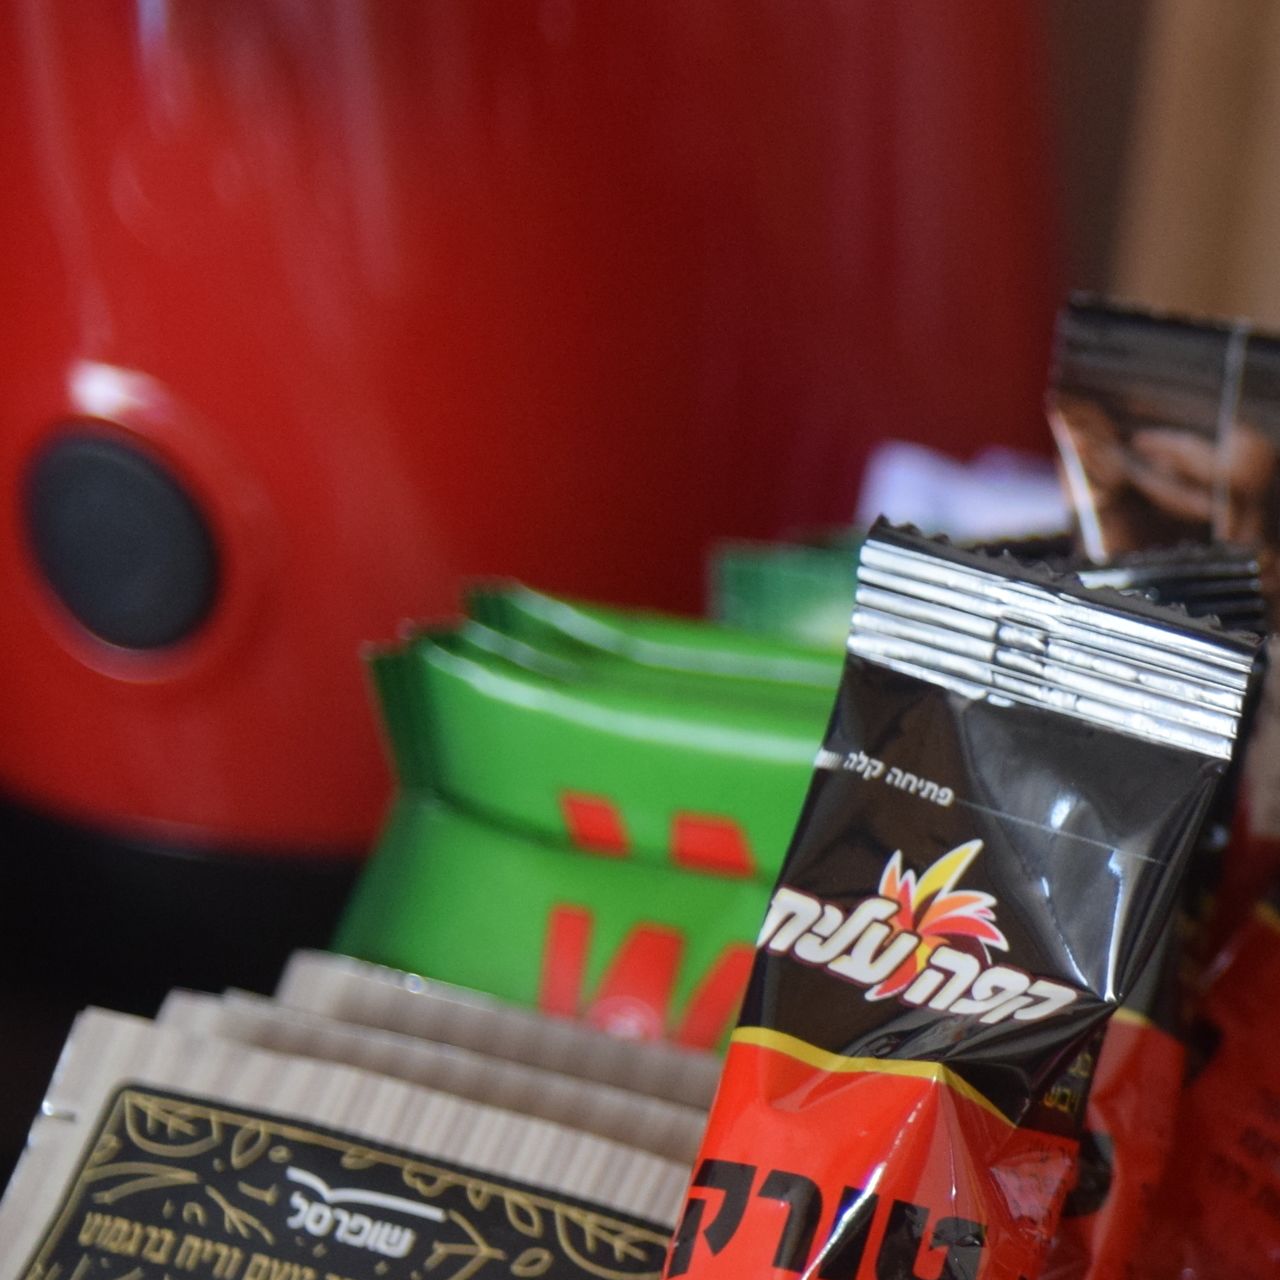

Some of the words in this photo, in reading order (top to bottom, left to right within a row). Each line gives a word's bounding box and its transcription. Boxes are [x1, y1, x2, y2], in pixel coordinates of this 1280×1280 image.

[842, 750, 885, 780] קלה
[885, 766, 954, 807] פתיחה
[903, 951, 1077, 1024] קפה
[77, 1210, 173, 1265] ברגמוט
[287, 1190, 416, 1259] שופרסל
[173, 1234, 244, 1280] וריח
